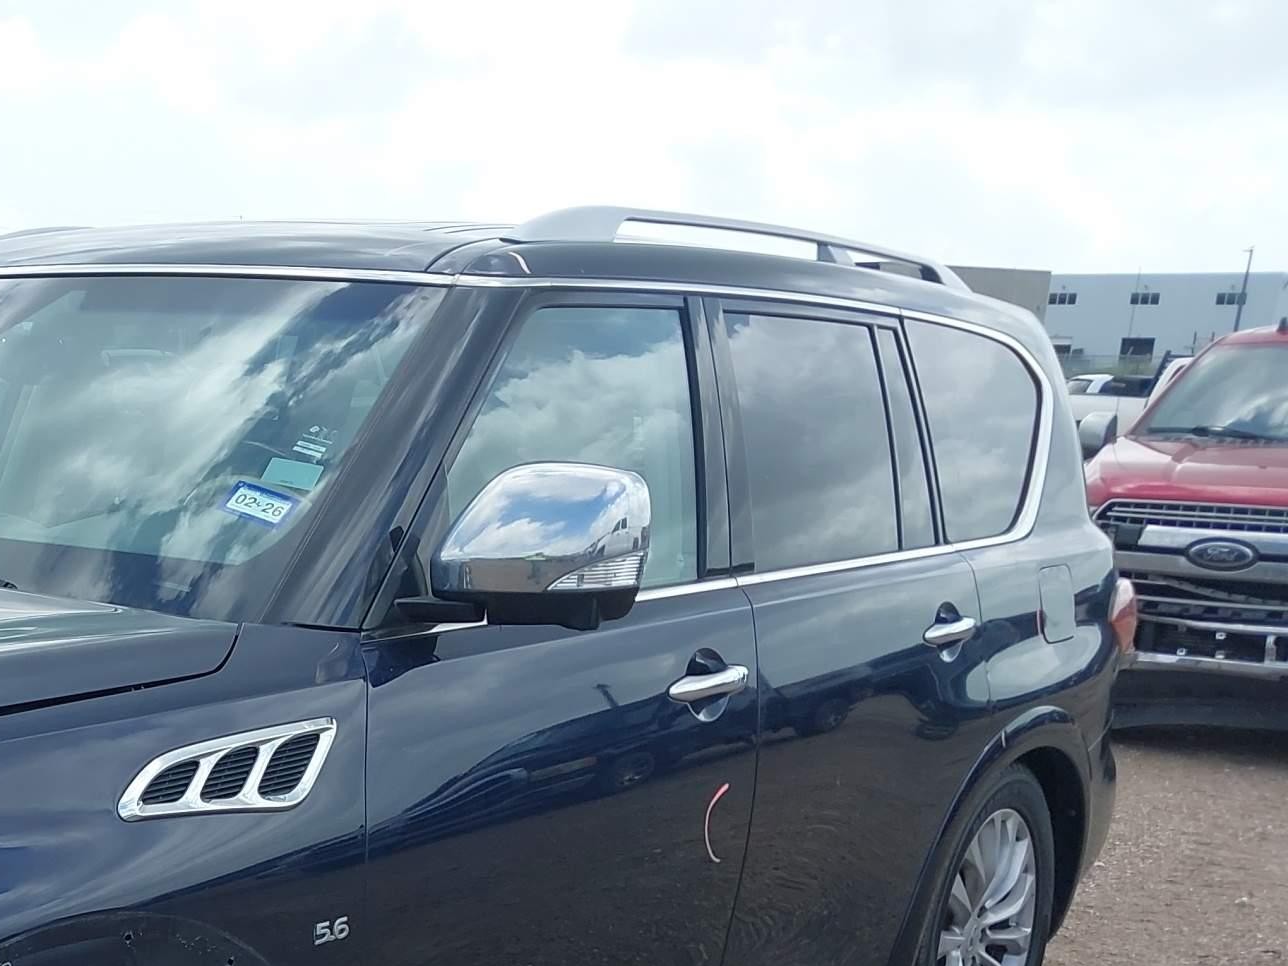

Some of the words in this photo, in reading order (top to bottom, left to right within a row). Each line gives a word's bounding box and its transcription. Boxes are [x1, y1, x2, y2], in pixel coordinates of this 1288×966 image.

[234, 493, 258, 508] 02
[261, 502, 285, 517] 26
[314, 916, 350, 946] 5.6
